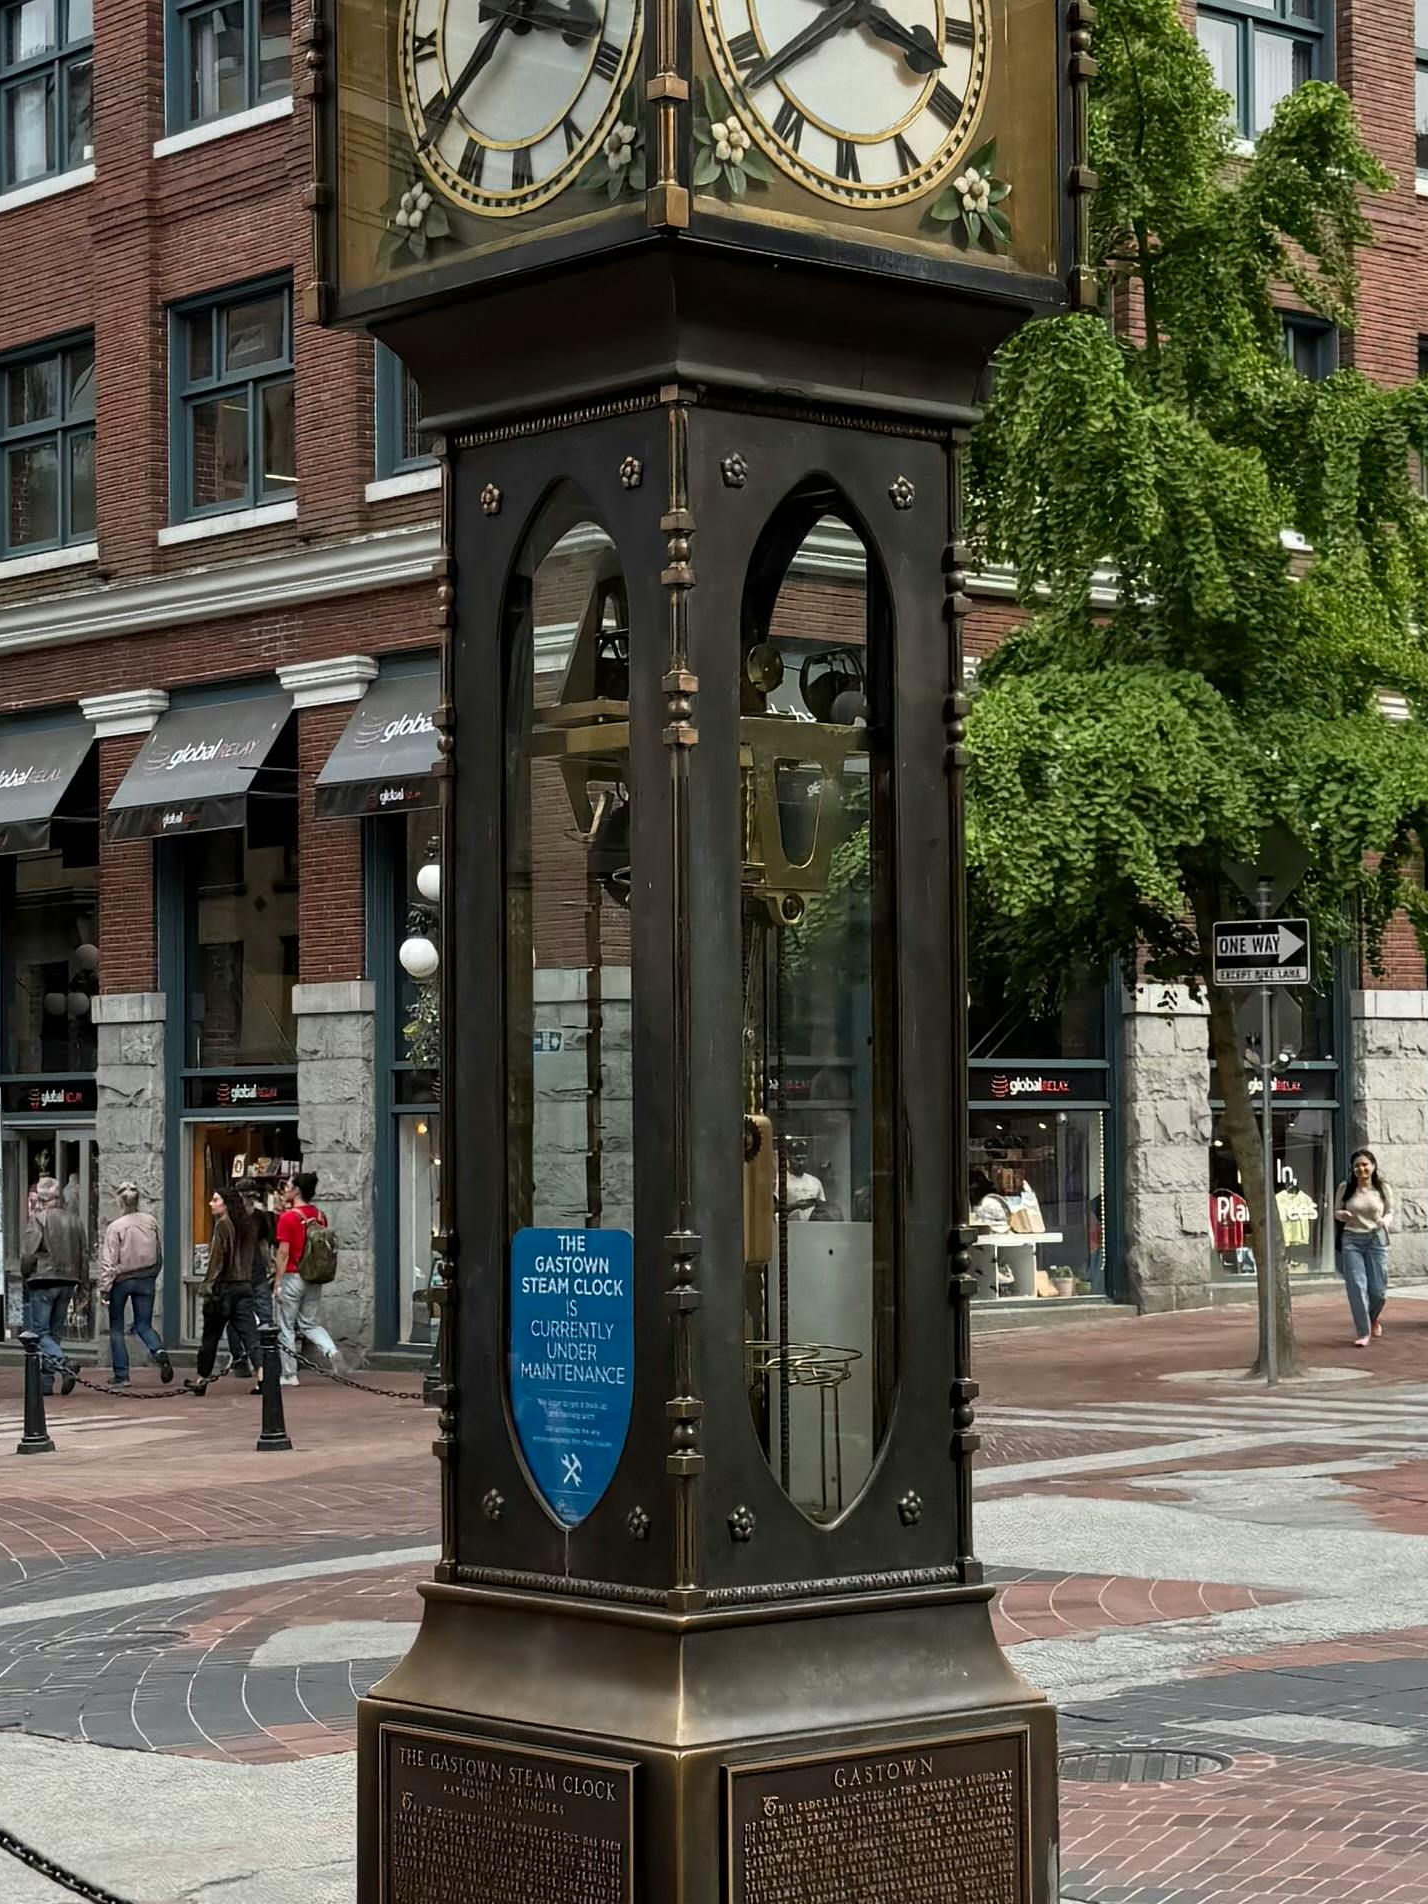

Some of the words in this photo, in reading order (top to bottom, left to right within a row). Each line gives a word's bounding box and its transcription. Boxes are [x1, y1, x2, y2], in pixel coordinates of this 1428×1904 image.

[1220, 937, 1246, 953] ONE
[1252, 936, 1280, 953] WAY
[558, 1236, 585, 1251] THE
[535, 1256, 609, 1274] GASTOWN
[522, 1278, 568, 1294] STEAM
[574, 1279, 623, 1296] CLOCK
[567, 1300, 577, 1316] IS
[531, 1320, 614, 1339] CURRENTLY
[547, 1341, 596, 1361] UNDER
[521, 1363, 625, 1384] MAINTENANCE
[399, 1748, 424, 1767] THE
[430, 1753, 501, 1780] GASTOWN
[508, 1767, 555, 1791] STEAM
[563, 1776, 616, 1802] CLOCK
[834, 1757, 933, 1788] GASTOWN
